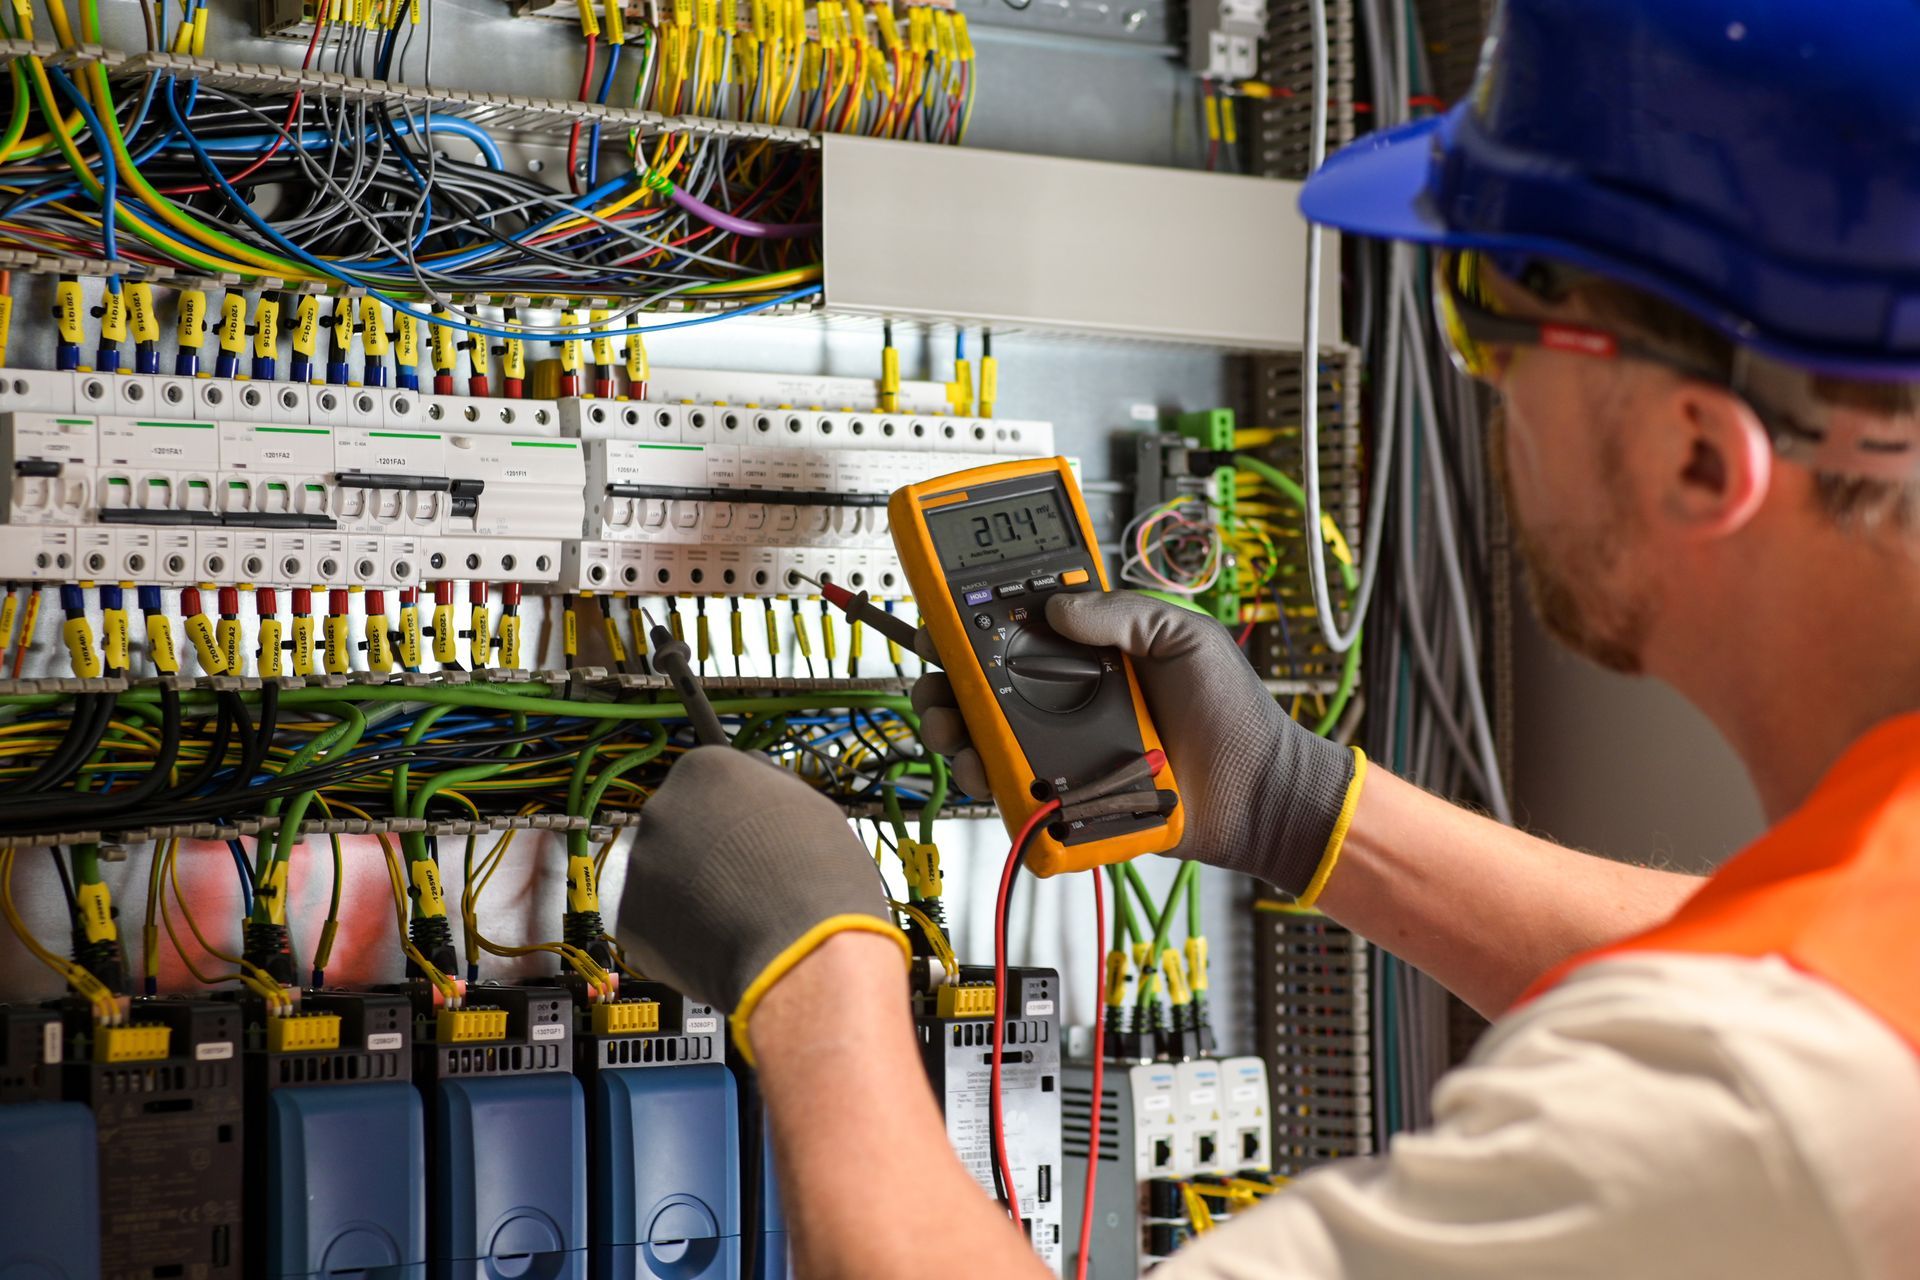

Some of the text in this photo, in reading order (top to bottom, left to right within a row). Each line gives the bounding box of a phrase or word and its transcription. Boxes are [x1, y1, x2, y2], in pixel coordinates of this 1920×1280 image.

[66, 291, 76, 331] 1201Q1:2
[109, 293, 120, 329] 201Q1:4
[133, 291, 146, 332] 1201Q1:6
[184, 298, 194, 336] 1201Q1:2
[228, 303, 238, 341] 1201Q1:4
[263, 309, 271, 348] 1201Q1:6
[301, 306, 314, 344] 1201Q1:2
[367, 306, 377, 345] 1201Q1:6
[433, 323, 443, 363] 201FA3:2
[511, 328, 520, 369] 101FA3:6
[151, 447, 182, 455] -1201FA1
[971, 507, 1038, 548] 20.4
[1036, 504, 1050, 515] mV
[969, 592, 988, 601] HOLD
[1033, 577, 1055, 586] RANGE
[78, 629, 91, 667] 120X40:1
[197, 622, 220, 664] 120X80:A1
[228, 626, 236, 671] 120X80:A2
[299, 626, 307, 667] 1201FI1:1
[328, 624, 336, 665] 1201FI1:3
[439, 612, 447, 655] 1205FA1:1
[999, 686, 1013, 695] OFF
[426, 868, 439, 904] -1295W3
[582, 865, 593, 901] -1295W4
